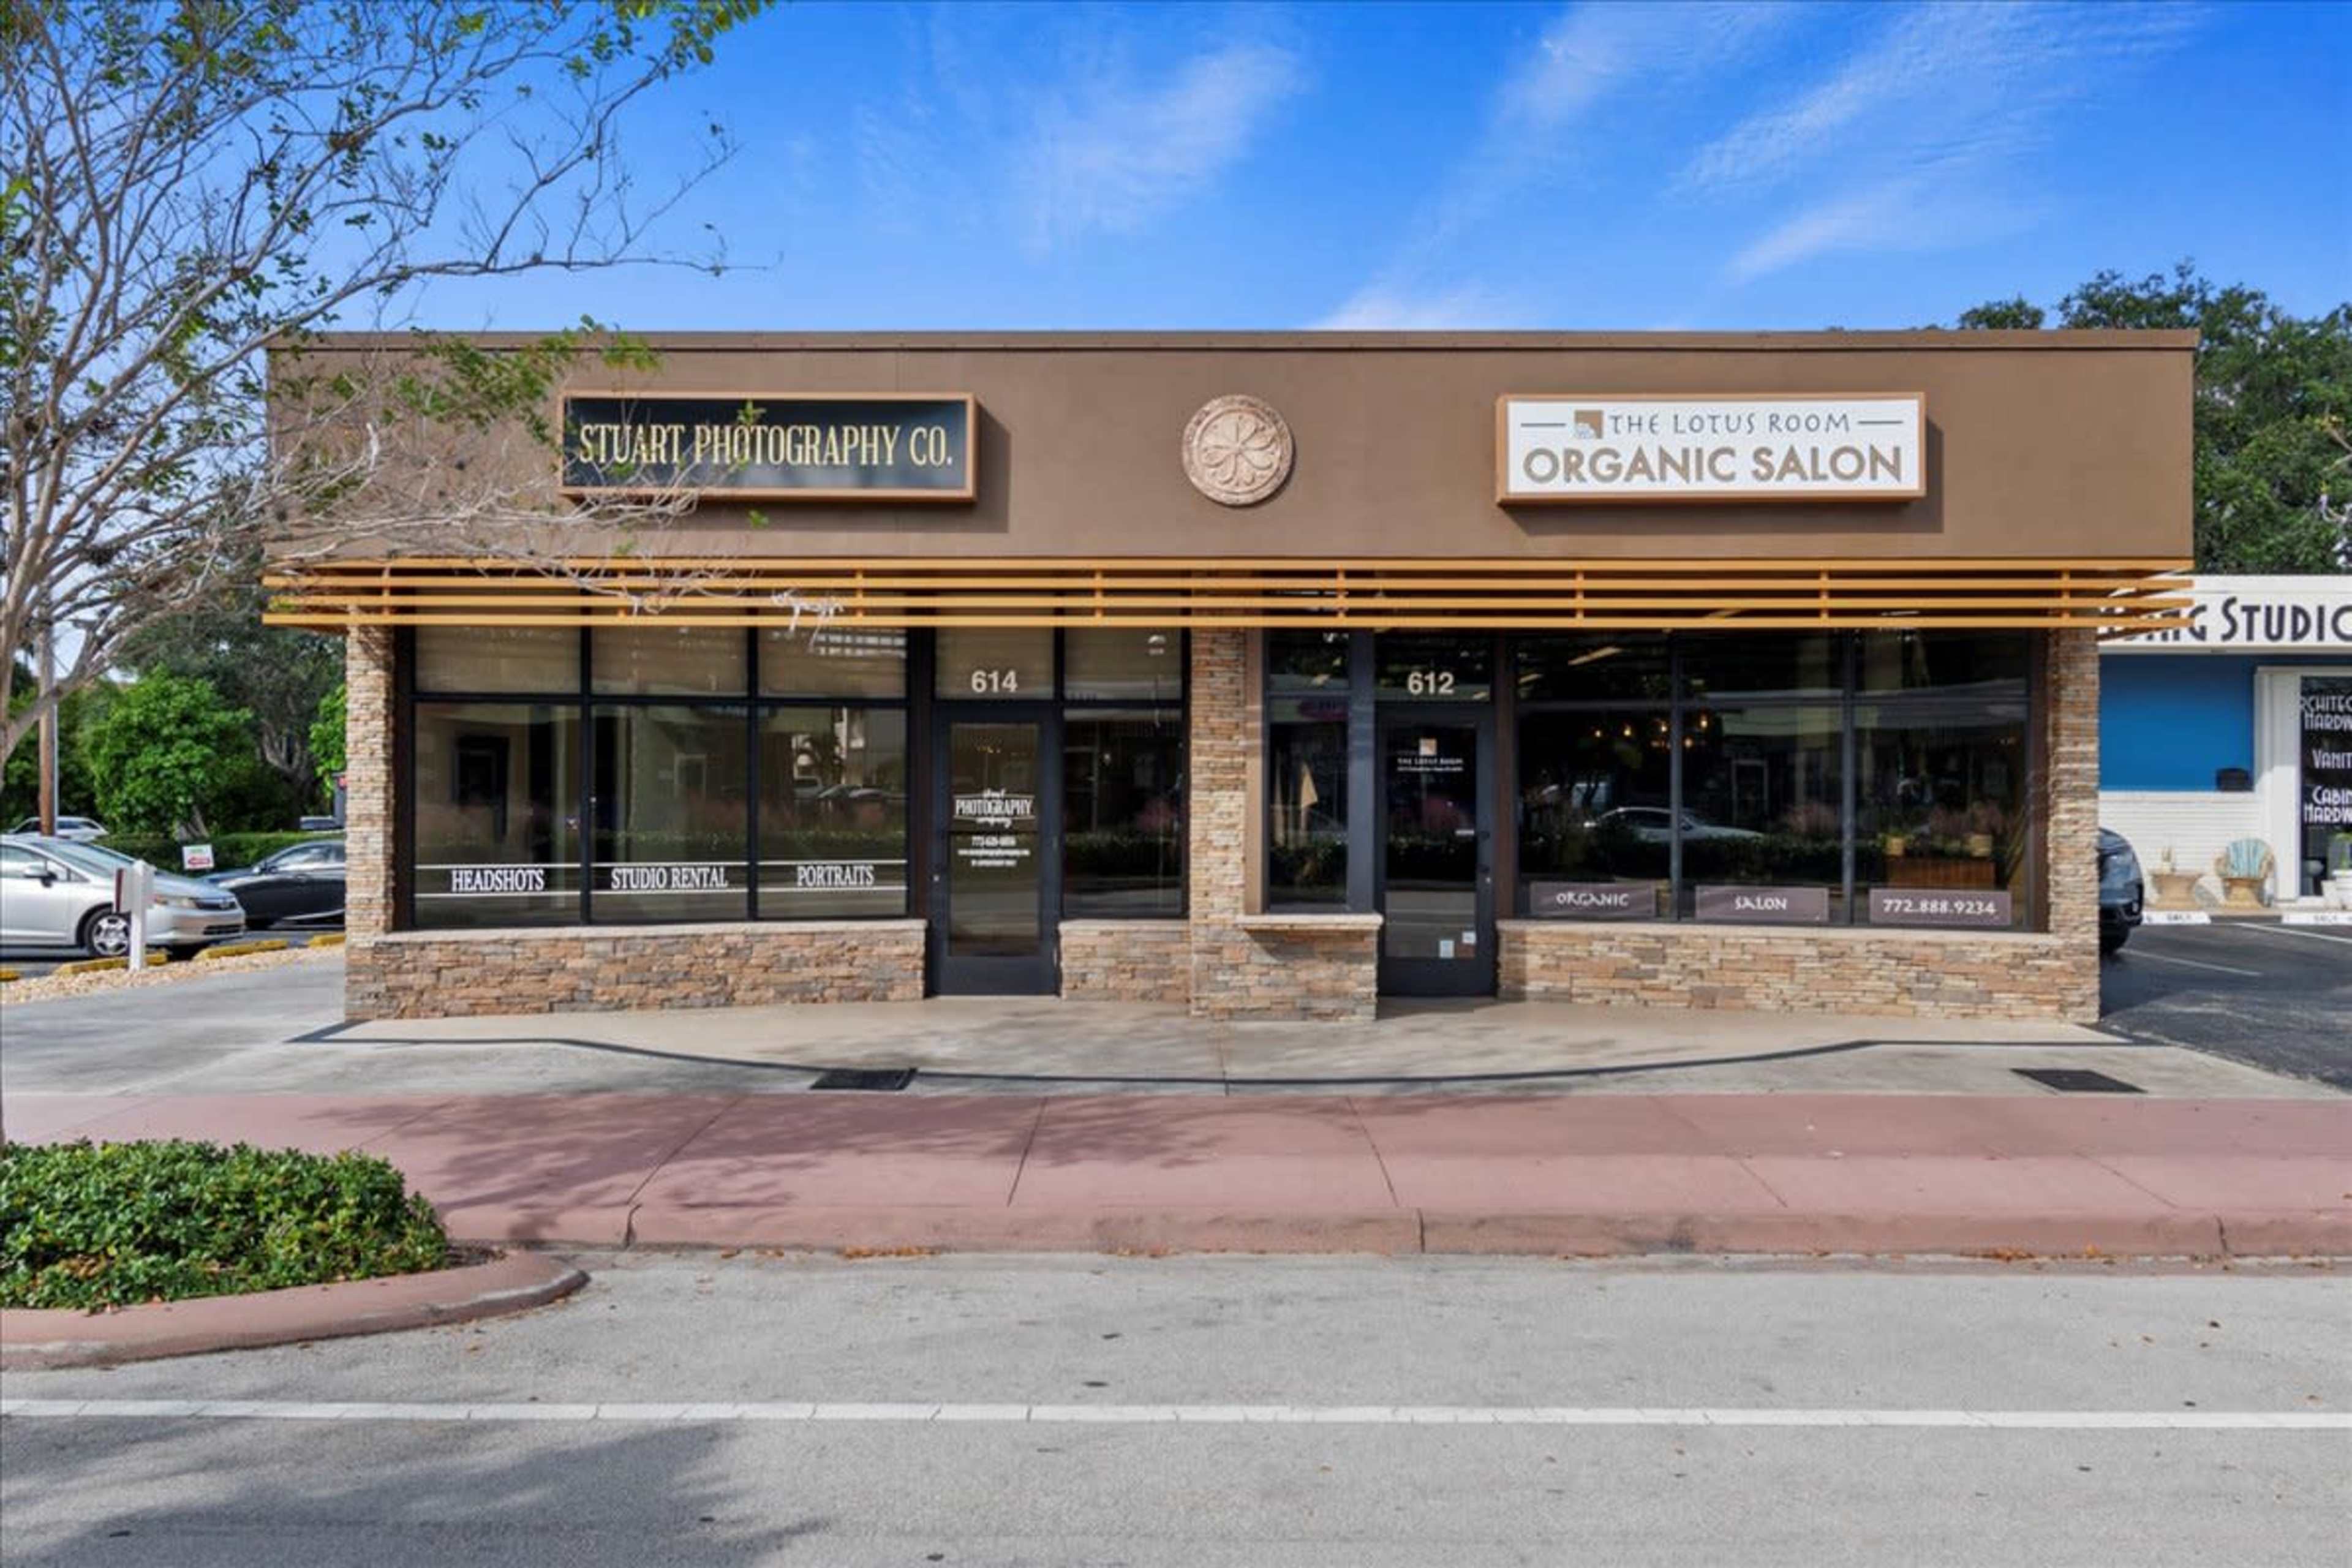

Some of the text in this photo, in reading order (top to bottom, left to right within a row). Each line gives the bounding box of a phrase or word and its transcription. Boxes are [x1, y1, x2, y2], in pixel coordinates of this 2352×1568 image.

[1608, 412, 1850, 434] THE LOTUS ROOM
[579, 424, 953, 466] STUART PHOTOGRAPHY CO.
[1523, 445, 1902, 484] ORGANIC SALON
[971, 670, 1018, 693] 614
[1408, 672, 1455, 695] 612
[956, 799, 1033, 815] PHOTOGRAPHY
[451, 869, 545, 892] HEADSHOTS
[611, 867, 728, 889] STUDIO RENTAL
[797, 865, 874, 886] PORTRAITS
[1556, 892, 1629, 907] ORGANIC
[1735, 896, 1787, 911] SALON
[1883, 892, 1997, 914] 772.888.9234
